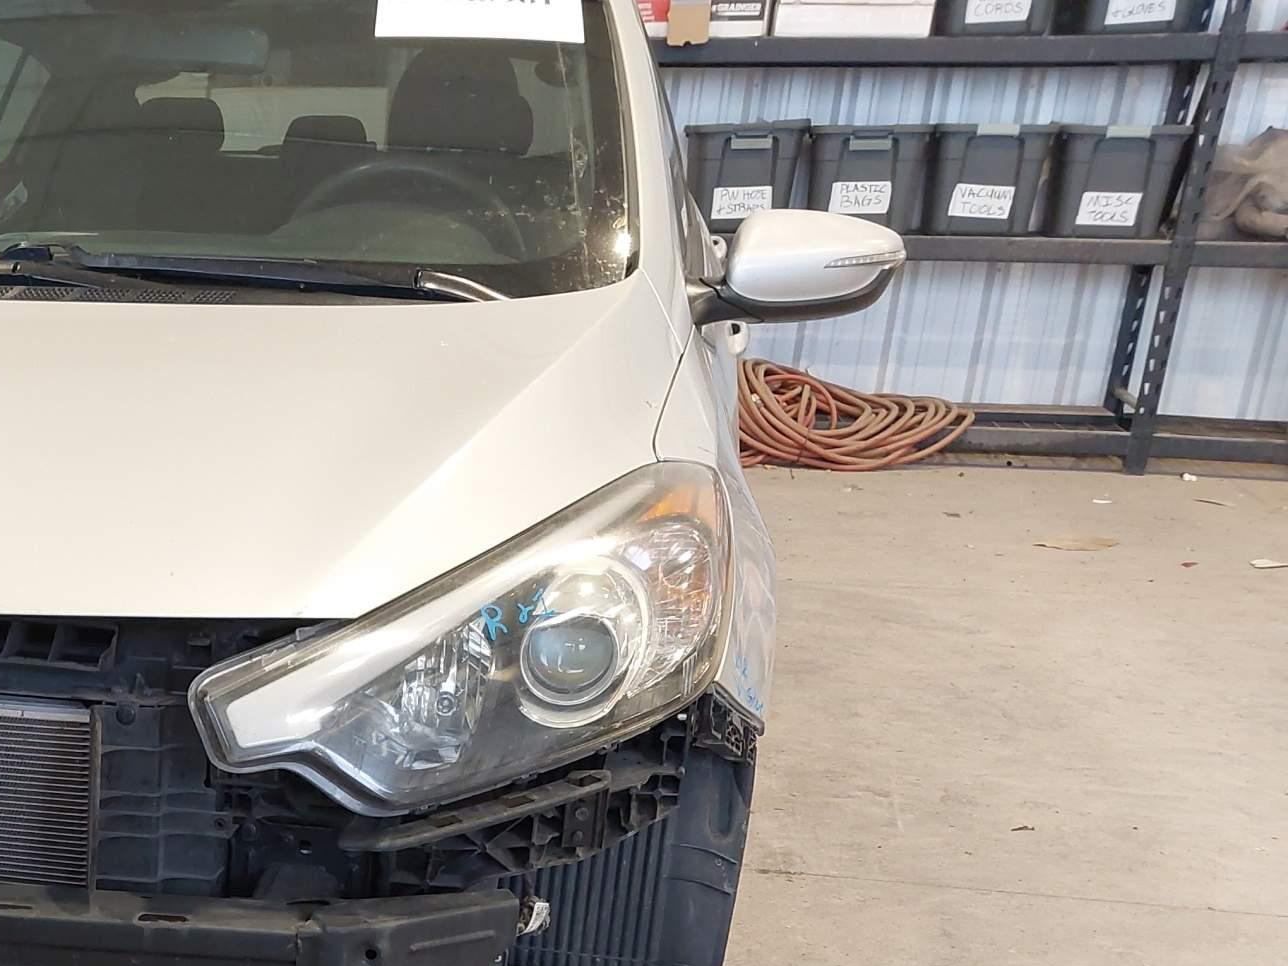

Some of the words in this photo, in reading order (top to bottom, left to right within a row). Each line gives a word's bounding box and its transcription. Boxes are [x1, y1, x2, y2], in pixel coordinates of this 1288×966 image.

[720, 188, 740, 201] PW
[840, 183, 886, 194] PLASTIC
[958, 186, 1012, 201] VACUUM
[840, 194, 882, 208] BAGS
[960, 201, 1006, 216] TOOLS
[1087, 210, 1129, 223] TOOLS
